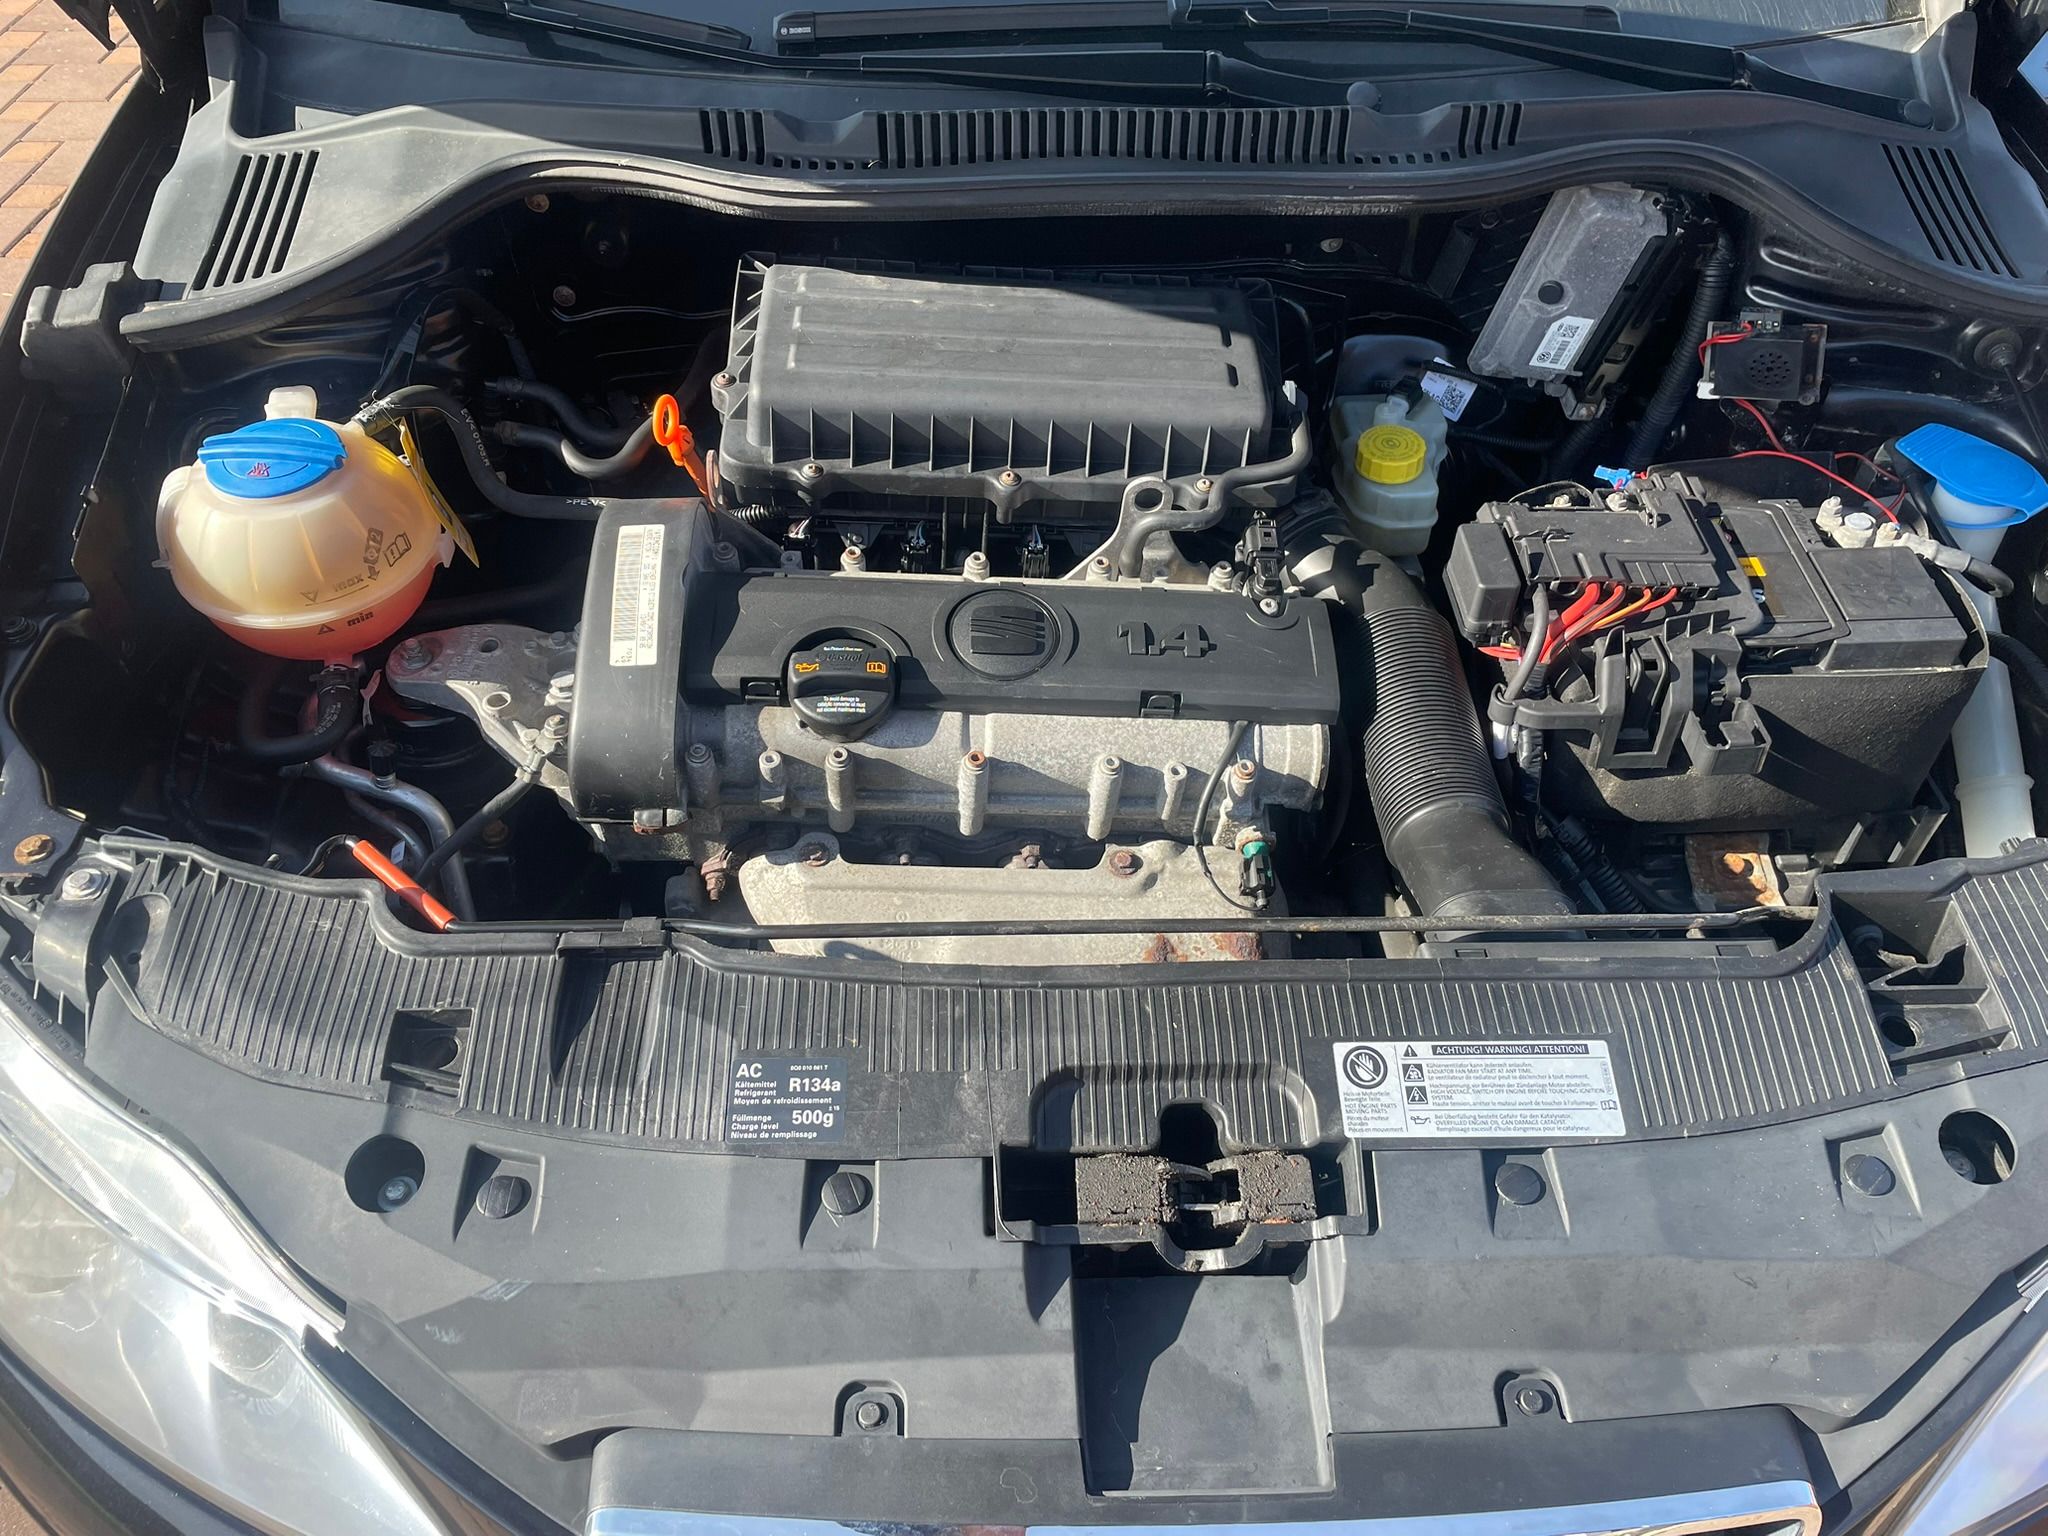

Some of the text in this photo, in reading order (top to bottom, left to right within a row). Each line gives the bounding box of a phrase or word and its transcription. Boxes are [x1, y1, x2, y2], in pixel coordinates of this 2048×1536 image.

[334, 572, 364, 593] max
[347, 609, 375, 627] min
[1436, 1046, 1585, 1054] ACHTUNG! WARNING! ATTENTION!
[736, 1063, 763, 1078] AC
[789, 1077, 841, 1092] R134a
[734, 1089, 776, 1098] Refrigerant
[734, 1097, 759, 1105] Moyen
[732, 1114, 771, 1122] Füllmenge
[792, 1110, 834, 1128] 500g
[731, 1123, 758, 1131] Charge
[771, 1131, 817, 1139] remplissage
